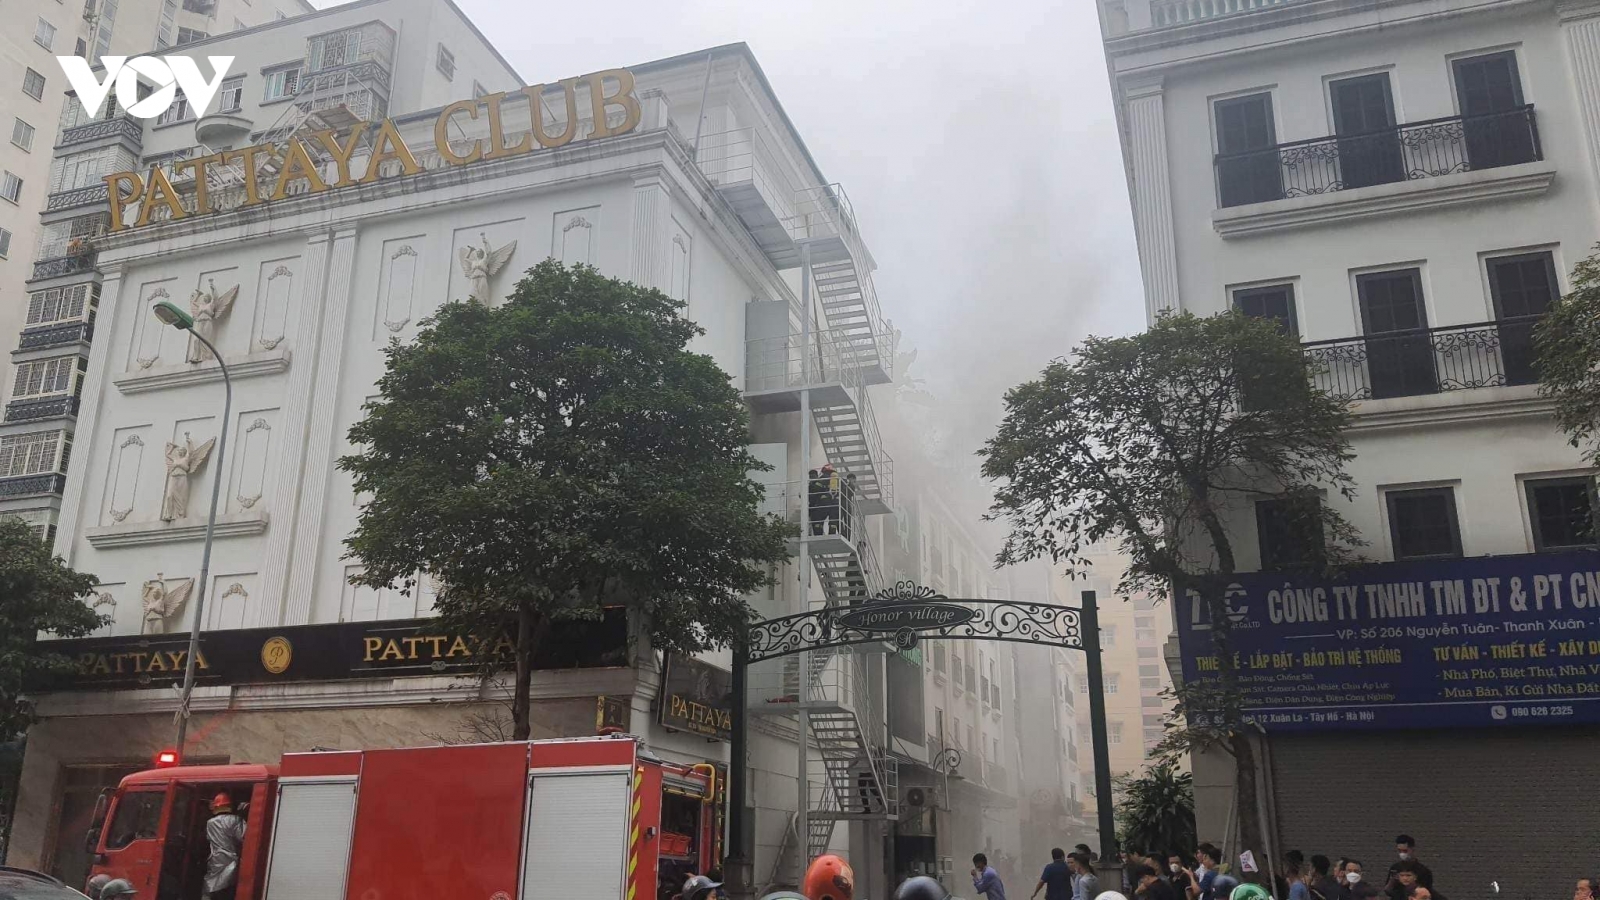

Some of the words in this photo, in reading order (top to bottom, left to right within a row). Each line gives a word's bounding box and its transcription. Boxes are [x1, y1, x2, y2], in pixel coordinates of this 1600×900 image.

[102, 117, 426, 233] PATTAYA
[433, 67, 643, 168] CLUB
[1267, 582, 1328, 624] CÔNG
[1333, 586, 1358, 620] TY
[1365, 582, 1426, 619] TNHH
[1430, 579, 1467, 616] TM
[1472, 577, 1500, 614] ĐT
[1510, 577, 1528, 612] &
[1533, 573, 1562, 611] PT
[857, 611, 904, 626] Honor
[908, 606, 955, 624] village
[1337, 629, 1358, 640] VP:
[1361, 627, 1377, 639] Số
[1380, 626, 1403, 638] 206
[1406, 622, 1459, 639] Nguyễn
[1503, 620, 1545, 632] Thanh
[1548, 618, 1585, 630] Xuân
[1303, 647, 1325, 667] BẢO
[1347, 647, 1362, 668] HỆ
[1364, 644, 1402, 664] THỐNG
[1452, 641, 1479, 661] VẤN
[1490, 640, 1526, 659] THIẾT
[1529, 638, 1547, 658] KẾ
[1558, 639, 1585, 656] XÂY
[77, 650, 210, 675] PATTAYA
[1443, 669, 1468, 680] Nhà
[1500, 666, 1525, 679] Biệt
[1559, 664, 1586, 676] Nhà
[1444, 687, 1473, 698] Mua
[1547, 683, 1574, 695] Nhà
[670, 694, 732, 731] PATTAYA
[1550, 705, 1573, 716] 2325
